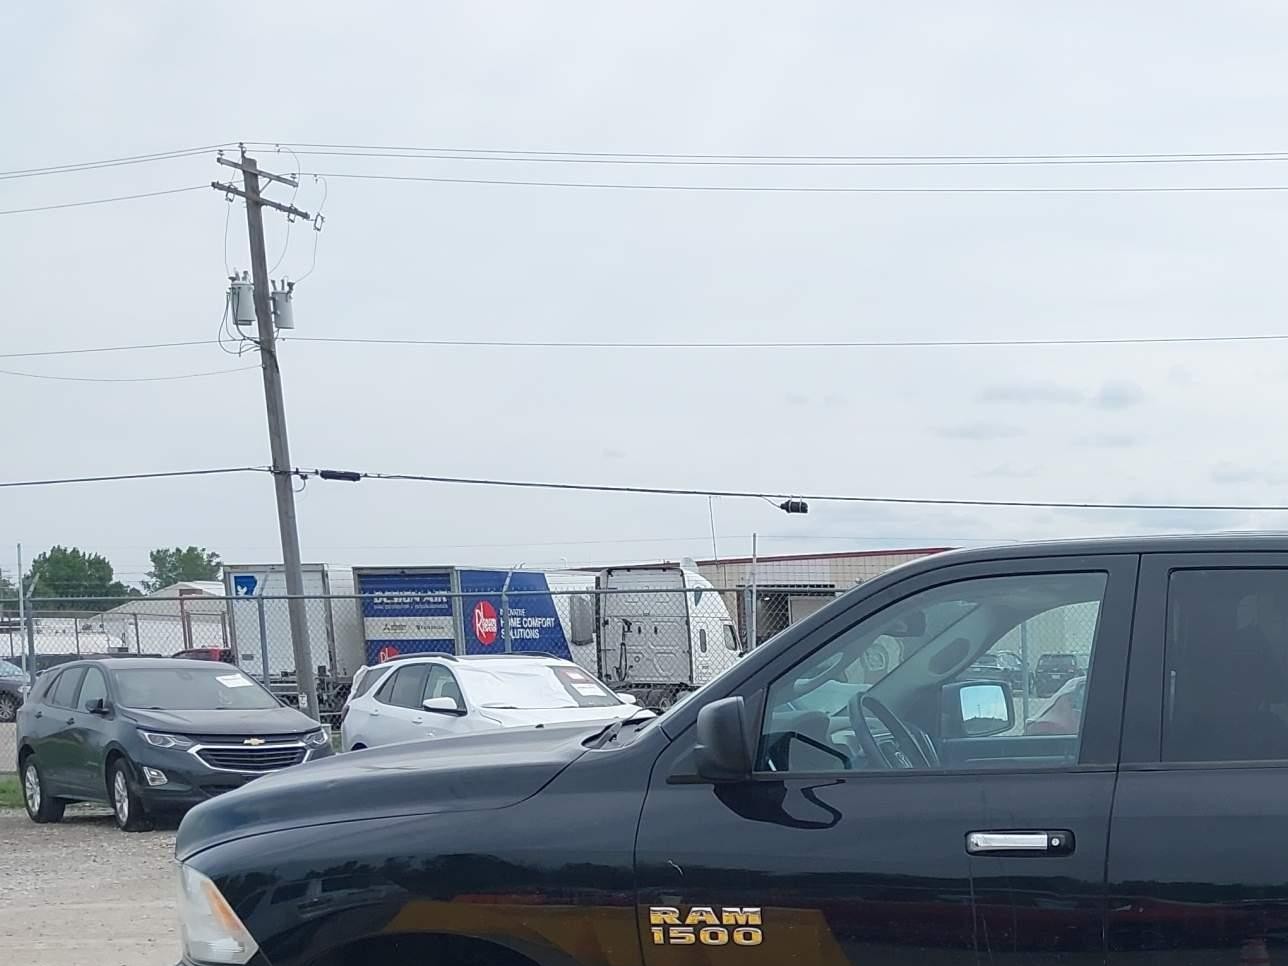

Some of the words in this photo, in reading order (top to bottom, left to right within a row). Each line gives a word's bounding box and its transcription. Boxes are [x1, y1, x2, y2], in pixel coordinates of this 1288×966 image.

[500, 617, 521, 628] HME
[522, 617, 555, 628] COMFORT
[501, 628, 540, 639] SLUTIONS
[649, 906, 763, 925] RAM
[651, 926, 763, 946] 1500
